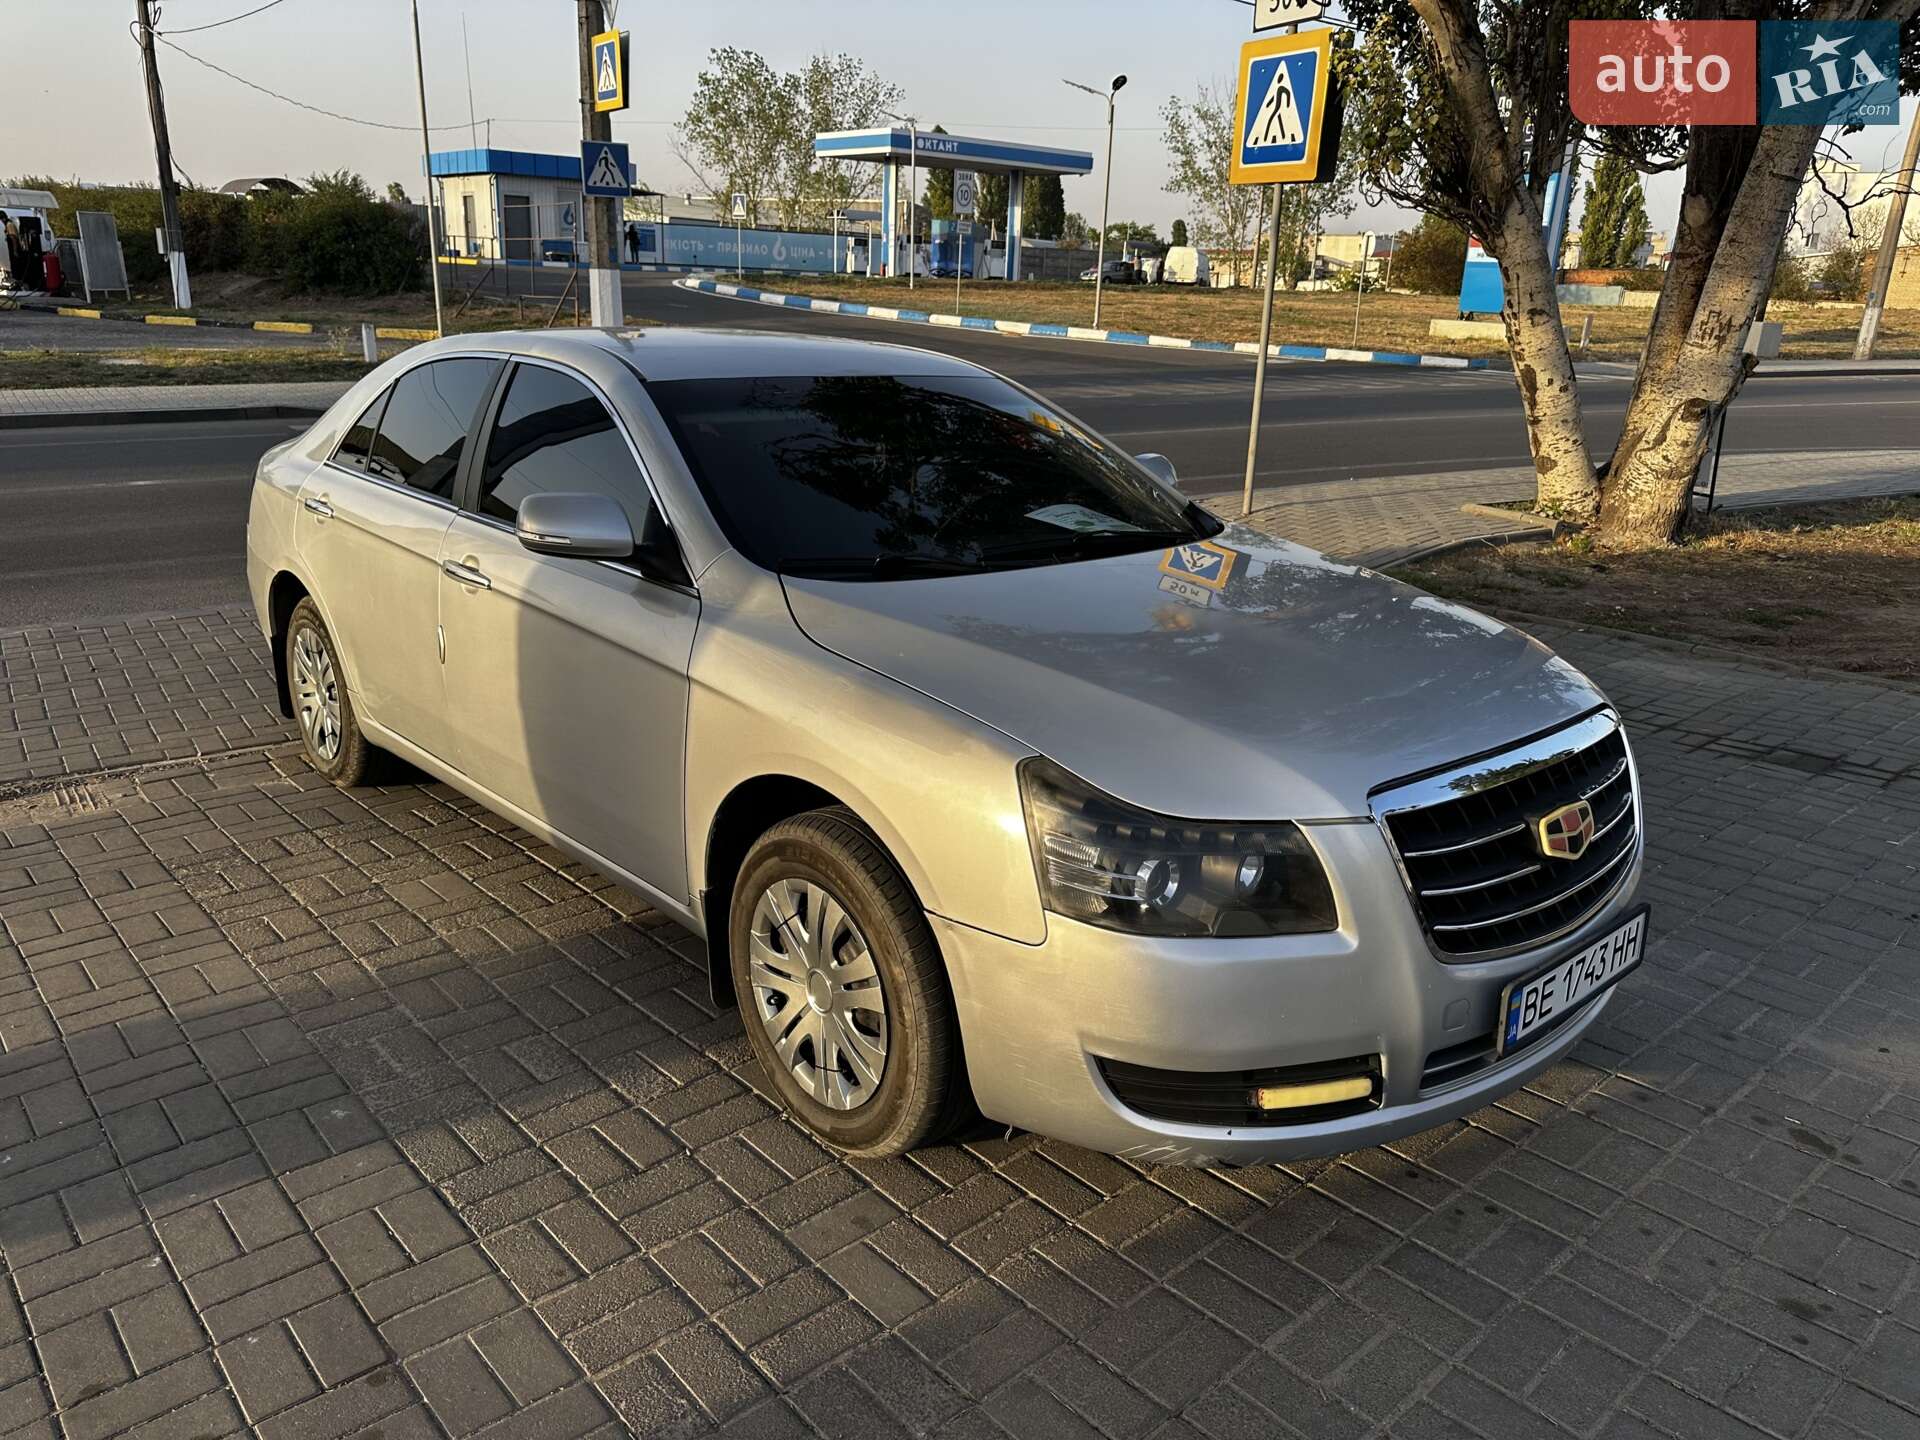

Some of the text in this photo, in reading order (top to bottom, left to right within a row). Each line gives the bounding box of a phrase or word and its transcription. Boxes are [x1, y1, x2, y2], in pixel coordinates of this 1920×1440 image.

[917, 138, 959, 152] ОКТАНТ
[960, 189, 969, 201] 10
[1521, 920, 1640, 1031] BE 1743 HH
